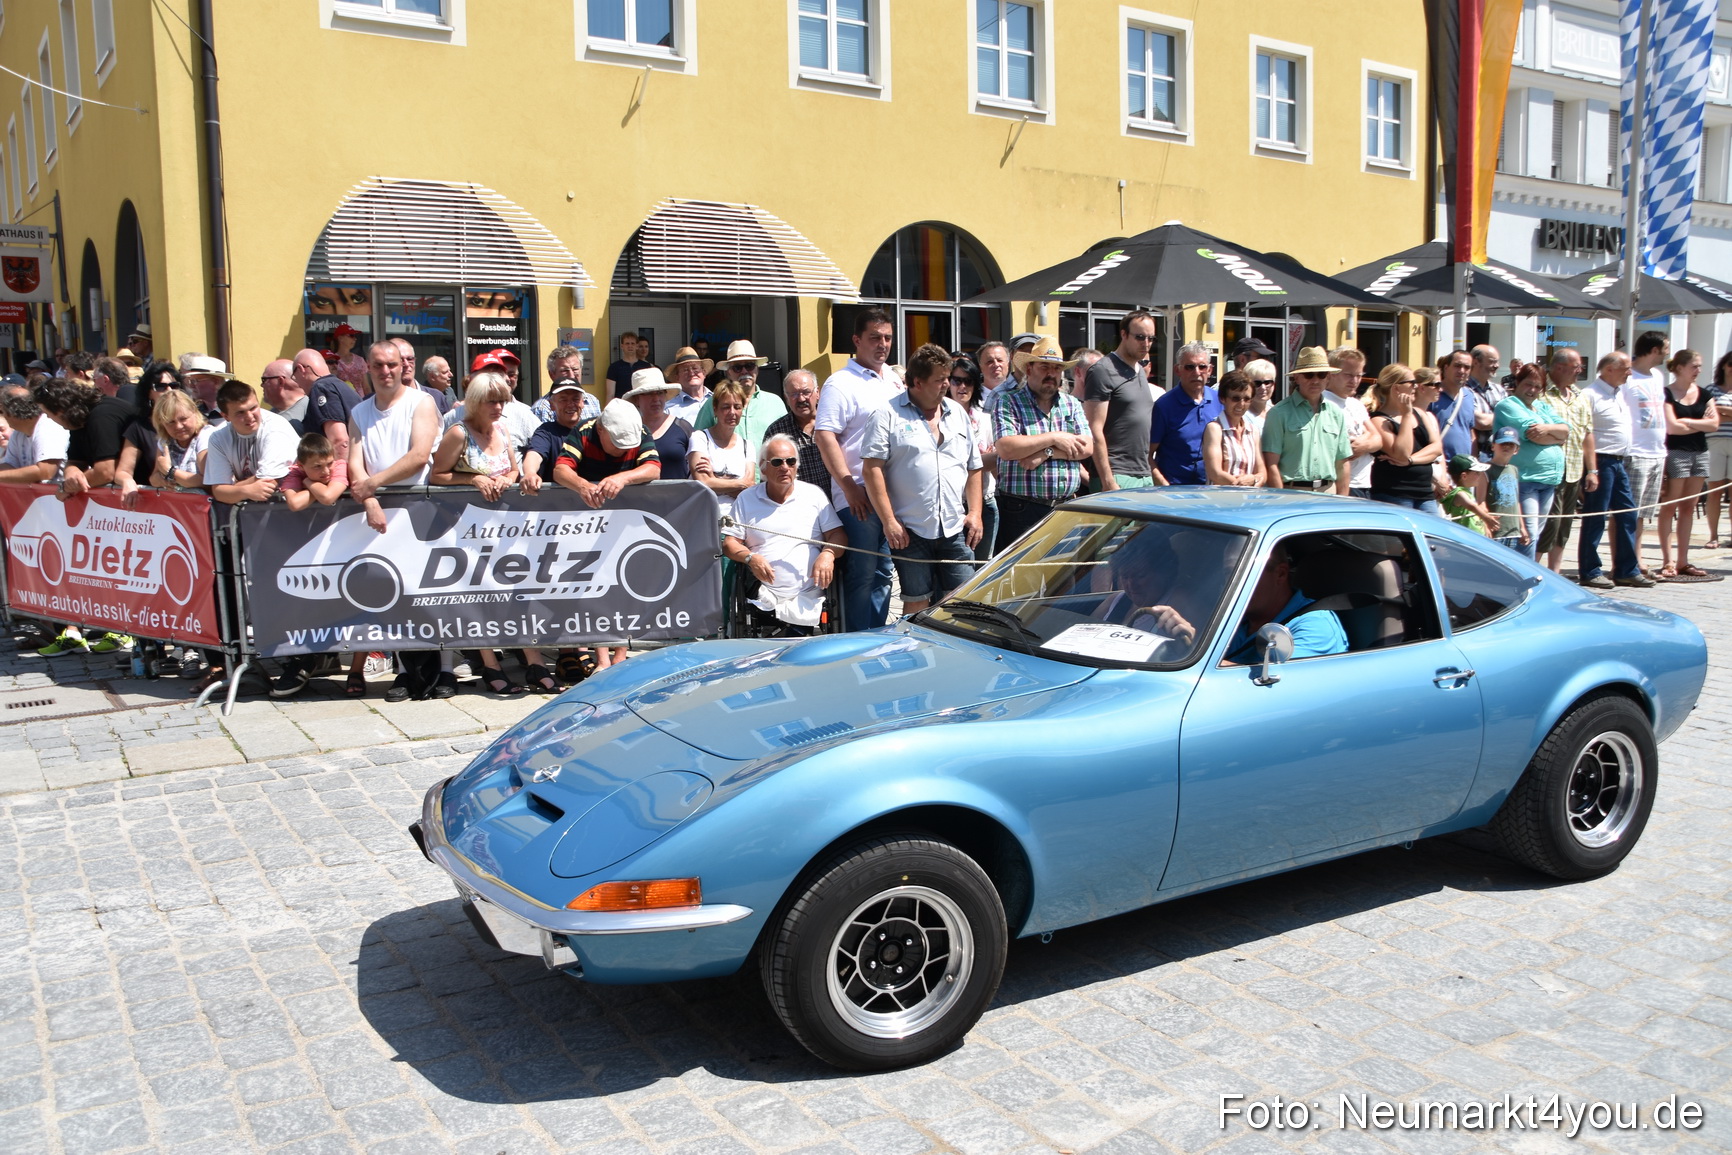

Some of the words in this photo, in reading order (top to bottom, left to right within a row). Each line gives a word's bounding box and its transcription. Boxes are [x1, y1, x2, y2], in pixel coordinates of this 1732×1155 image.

[37, 230, 44, 239] II
[1541, 219, 1621, 255] BRILLEN
[1055, 250, 1131, 291] now
[1203, 250, 1283, 291] now
[480, 323, 516, 331] Passbilder
[1411, 324, 1422, 337] 24
[467, 337, 529, 346] Bewerbungsbilder
[86, 515, 156, 535] Autoklassik
[461, 516, 609, 540] Autoklassik
[71, 534, 153, 578] Dietz
[419, 541, 602, 589] Dietz
[68, 575, 114, 589] BREITENBRUNN
[411, 592, 513, 607] BREITENBRUNN
[17, 589, 202, 634] www.autoklassik-dietz.de
[286, 606, 690, 646] www.autoklassik-dietz.de
[1109, 631, 1144, 643] 641
